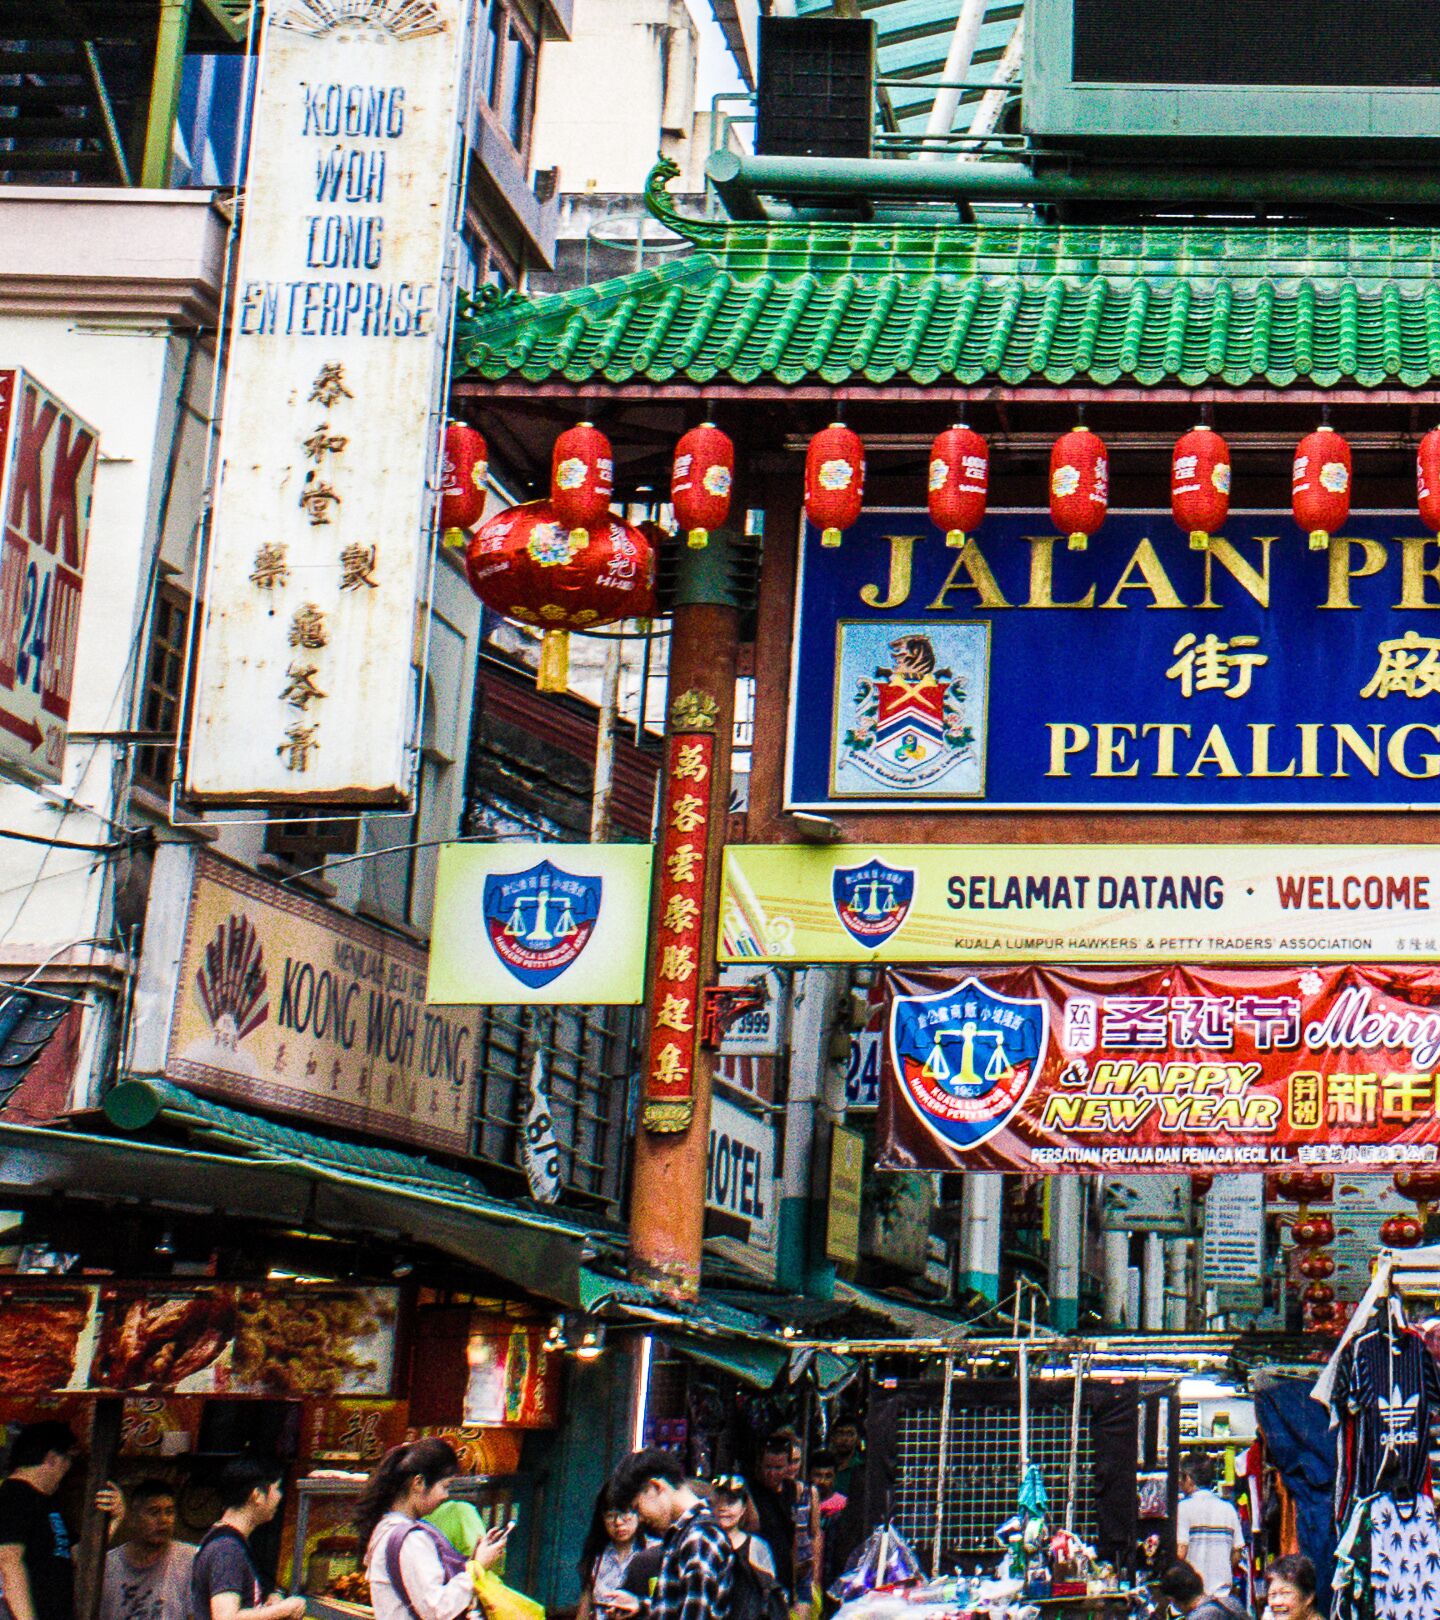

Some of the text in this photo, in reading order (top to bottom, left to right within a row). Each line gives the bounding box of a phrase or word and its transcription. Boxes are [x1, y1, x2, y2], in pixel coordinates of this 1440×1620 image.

[302, 85, 407, 139] KOONG
[316, 149, 386, 204] WOH
[305, 215, 385, 270] TONG
[240, 281, 437, 337] ENTERPRISE
[12, 383, 94, 570] KK
[860, 536, 1281, 610] JALAN
[947, 875, 1431, 911] SELAMAT DATANG WELCOME
[955, 938, 1001, 949] KUALA
[1005, 938, 1064, 949] LUMPUR
[1146, 938, 1155, 949] &
[1160, 938, 1202, 949] PETTY
[1279, 938, 1373, 950] ASSOCIATION
[279, 957, 360, 1051] KOONG
[366, 990, 419, 1068] WOH
[420, 1012, 469, 1087] TONG
[1069, 1003, 1092, 1047] 欢庆
[1103, 997, 1300, 1049] 圣诞节
[1060, 1060, 1262, 1096] & HAPPY
[1042, 1095, 1282, 1132] NEW YEAR
[1031, 1147, 1100, 1163] PERSATUAN
[1101, 1147, 1154, 1163] PENJAJA
[1155, 1147, 1180, 1163] DAN
[1182, 1147, 1233, 1163] PENIAGA
[1234, 1147, 1268, 1163] KECIL
